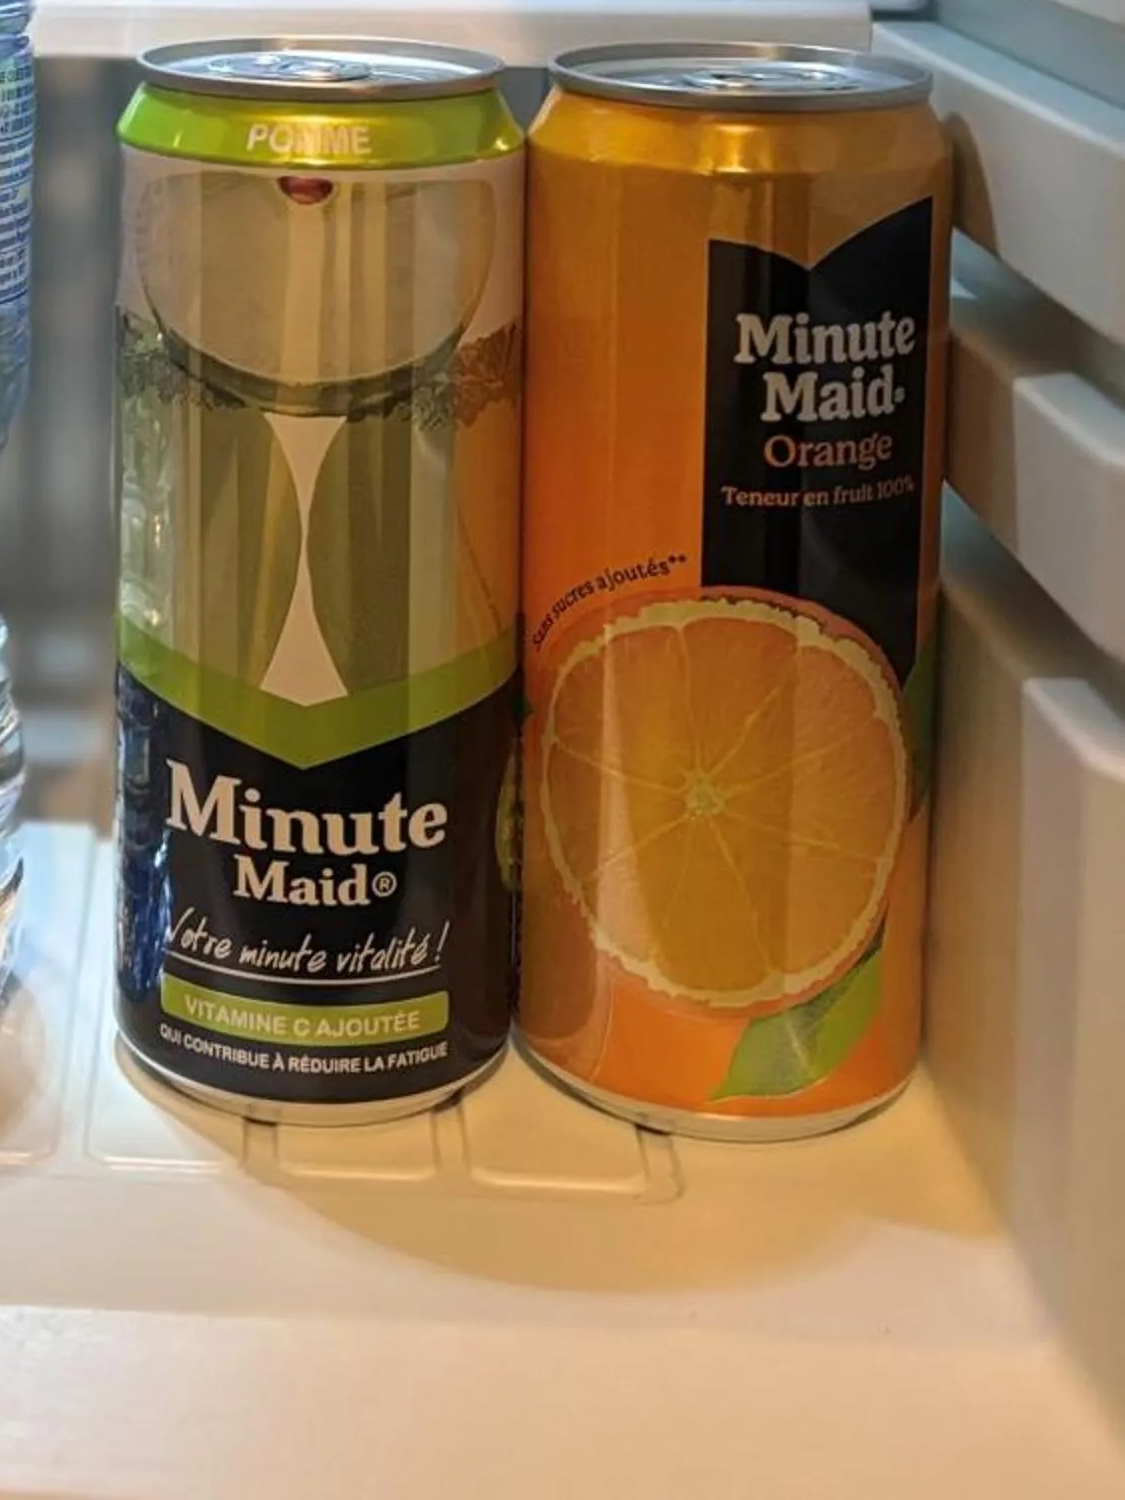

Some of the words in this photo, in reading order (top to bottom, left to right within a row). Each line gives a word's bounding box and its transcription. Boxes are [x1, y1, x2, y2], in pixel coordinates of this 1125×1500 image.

[246, 123, 373, 155] POMME
[732, 310, 917, 366] Minute
[763, 431, 894, 472] Orange
[720, 485, 801, 507] Teneur
[803, 490, 829, 507] en
[833, 483, 874, 505] fruit
[876, 474, 915, 501] 100%
[164, 758, 449, 856] Minute
[238, 932, 327, 974] minute
[335, 926, 432, 974] vitalité
[184, 995, 287, 1035] VITAMINE
[292, 1016, 311, 1038] C
[315, 1009, 421, 1038] AJOUTÉE
[159, 1022, 182, 1046] QUI
[183, 1032, 270, 1070] CONTRIBUE
[271, 1051, 285, 1072] À
[288, 1052, 362, 1075] RÉDUIRE
[364, 1055, 386, 1073] LA
[387, 1040, 449, 1070] FATIGUE
